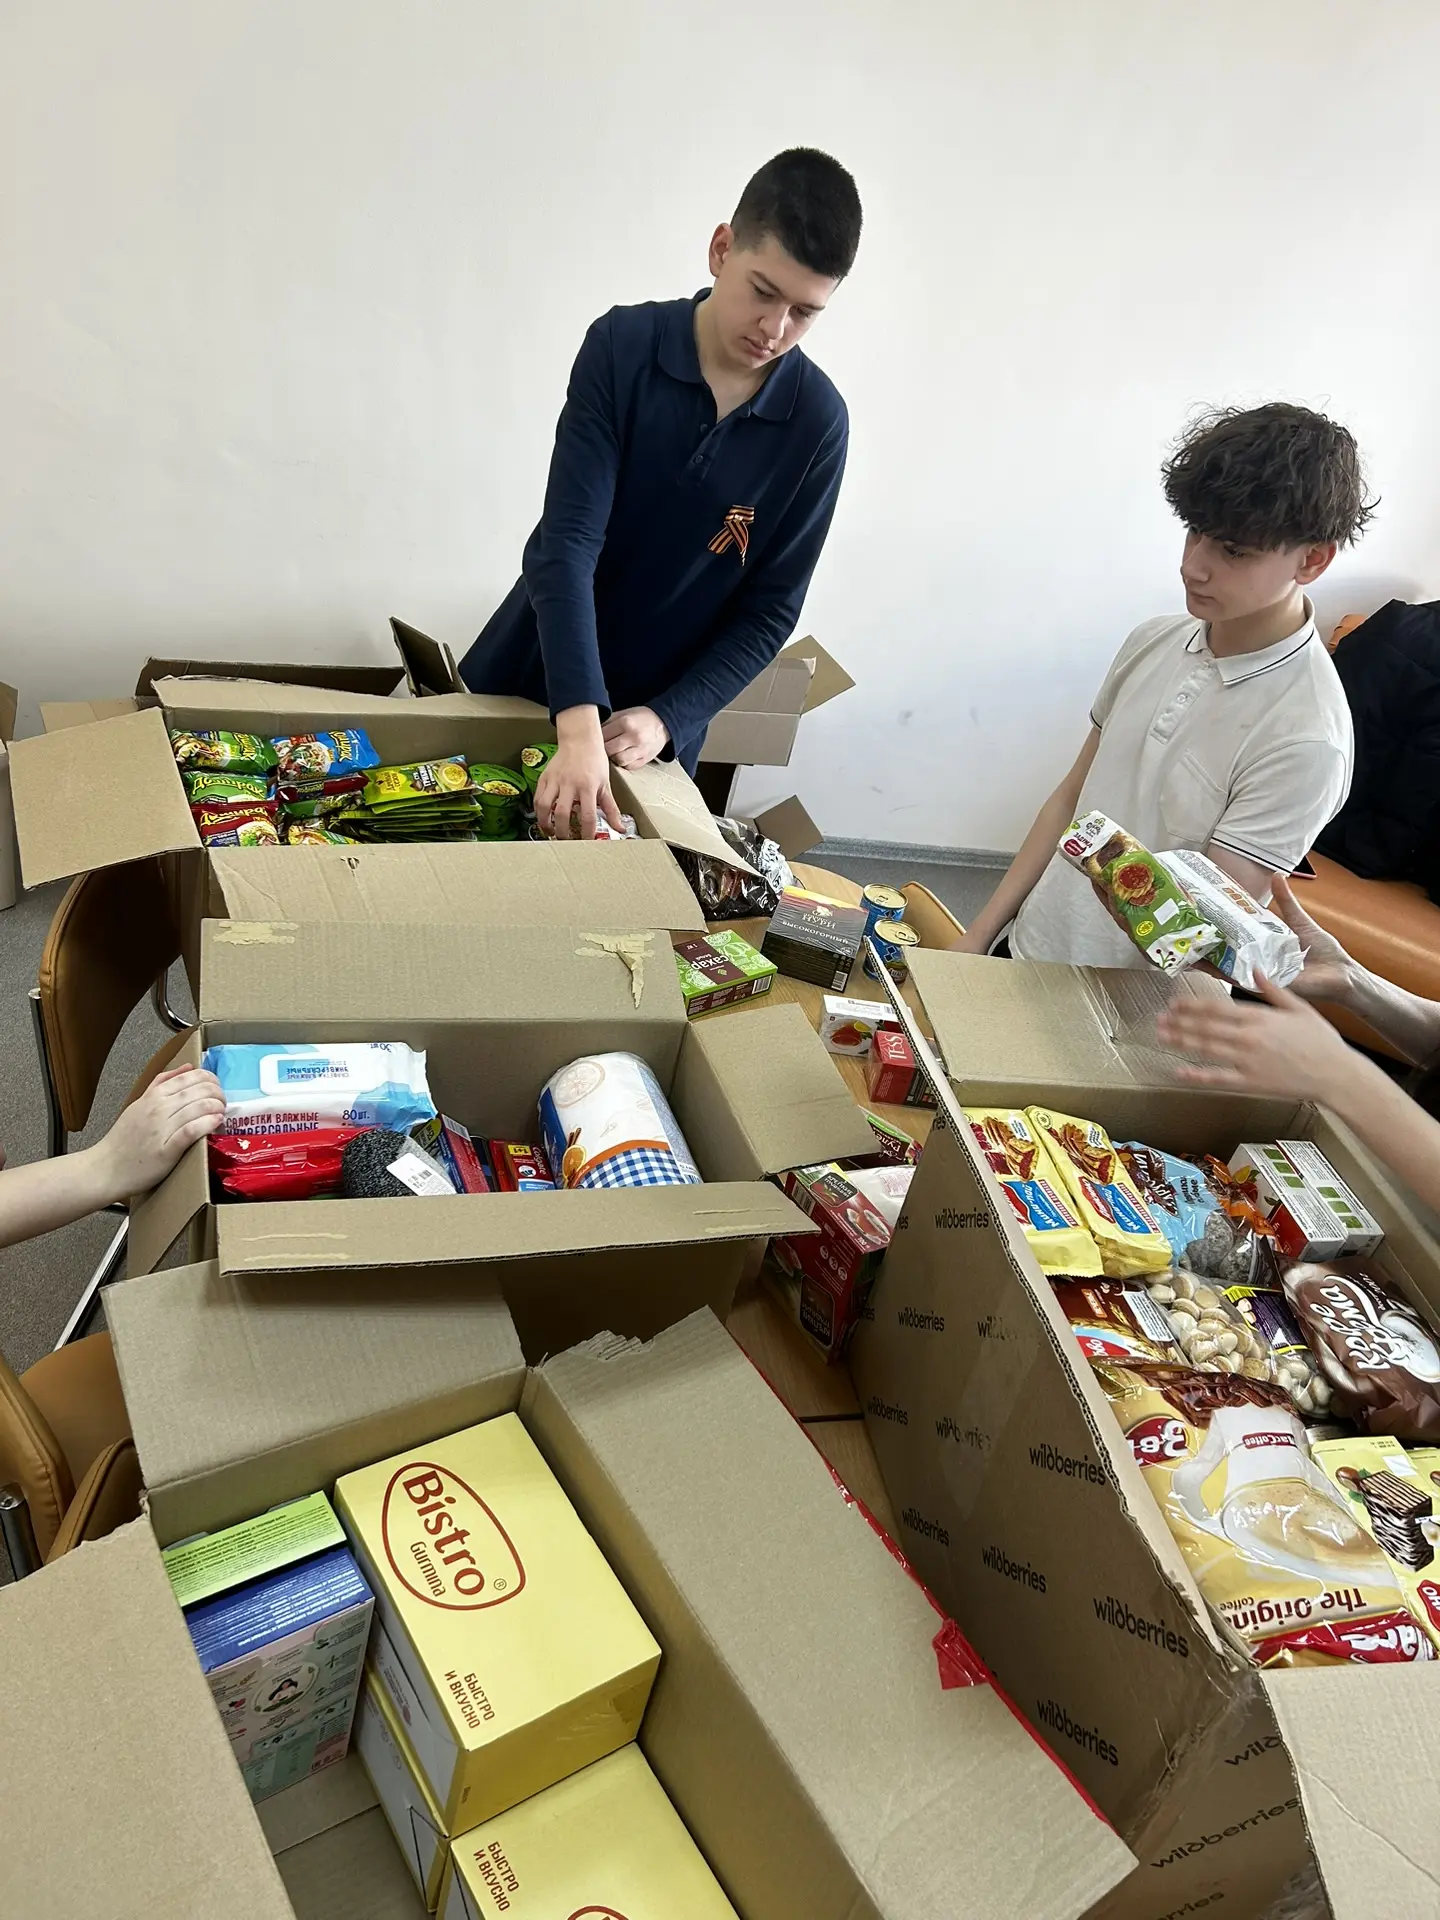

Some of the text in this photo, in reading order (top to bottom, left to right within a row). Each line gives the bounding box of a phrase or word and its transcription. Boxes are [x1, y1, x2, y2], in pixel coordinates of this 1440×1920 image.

[781, 920, 850, 945] ВЫСОКОГОРНЫЙ
[691, 954, 730, 970] сахар
[887, 1035, 908, 1060] TESS
[226, 1112, 319, 1129] САЛФЕТКИ ВЛАЖНЫЕ
[342, 1109, 357, 1120] 80
[532, 1146, 547, 1175] Colgate
[876, 1132, 901, 1152] Руле
[935, 1207, 989, 1230] wildberries
[898, 1307, 945, 1332] wildberries
[1310, 1303, 1390, 1369] Кофе
[867, 1396, 908, 1426] wildberries
[1029, 1443, 1106, 1487] wildberries
[402, 1470, 485, 1596] Bistro
[902, 1508, 949, 1547] wildberries
[410, 1542, 446, 1598] Gurmina
[982, 1546, 1047, 1594] wildberries
[1220, 1596, 1254, 1612] Coffee
[1226, 1588, 1367, 1631] The Origin
[1093, 1596, 1190, 1658] wildberries
[449, 1681, 481, 1730] ВКУСНО
[464, 1672, 496, 1721] БЫСТРО
[1036, 1700, 1119, 1767] wildberries
[1150, 1797, 1300, 1868] wildberries
[478, 1860, 511, 1912] ВКУСНО
[488, 1841, 520, 1892] БЫСТРО
